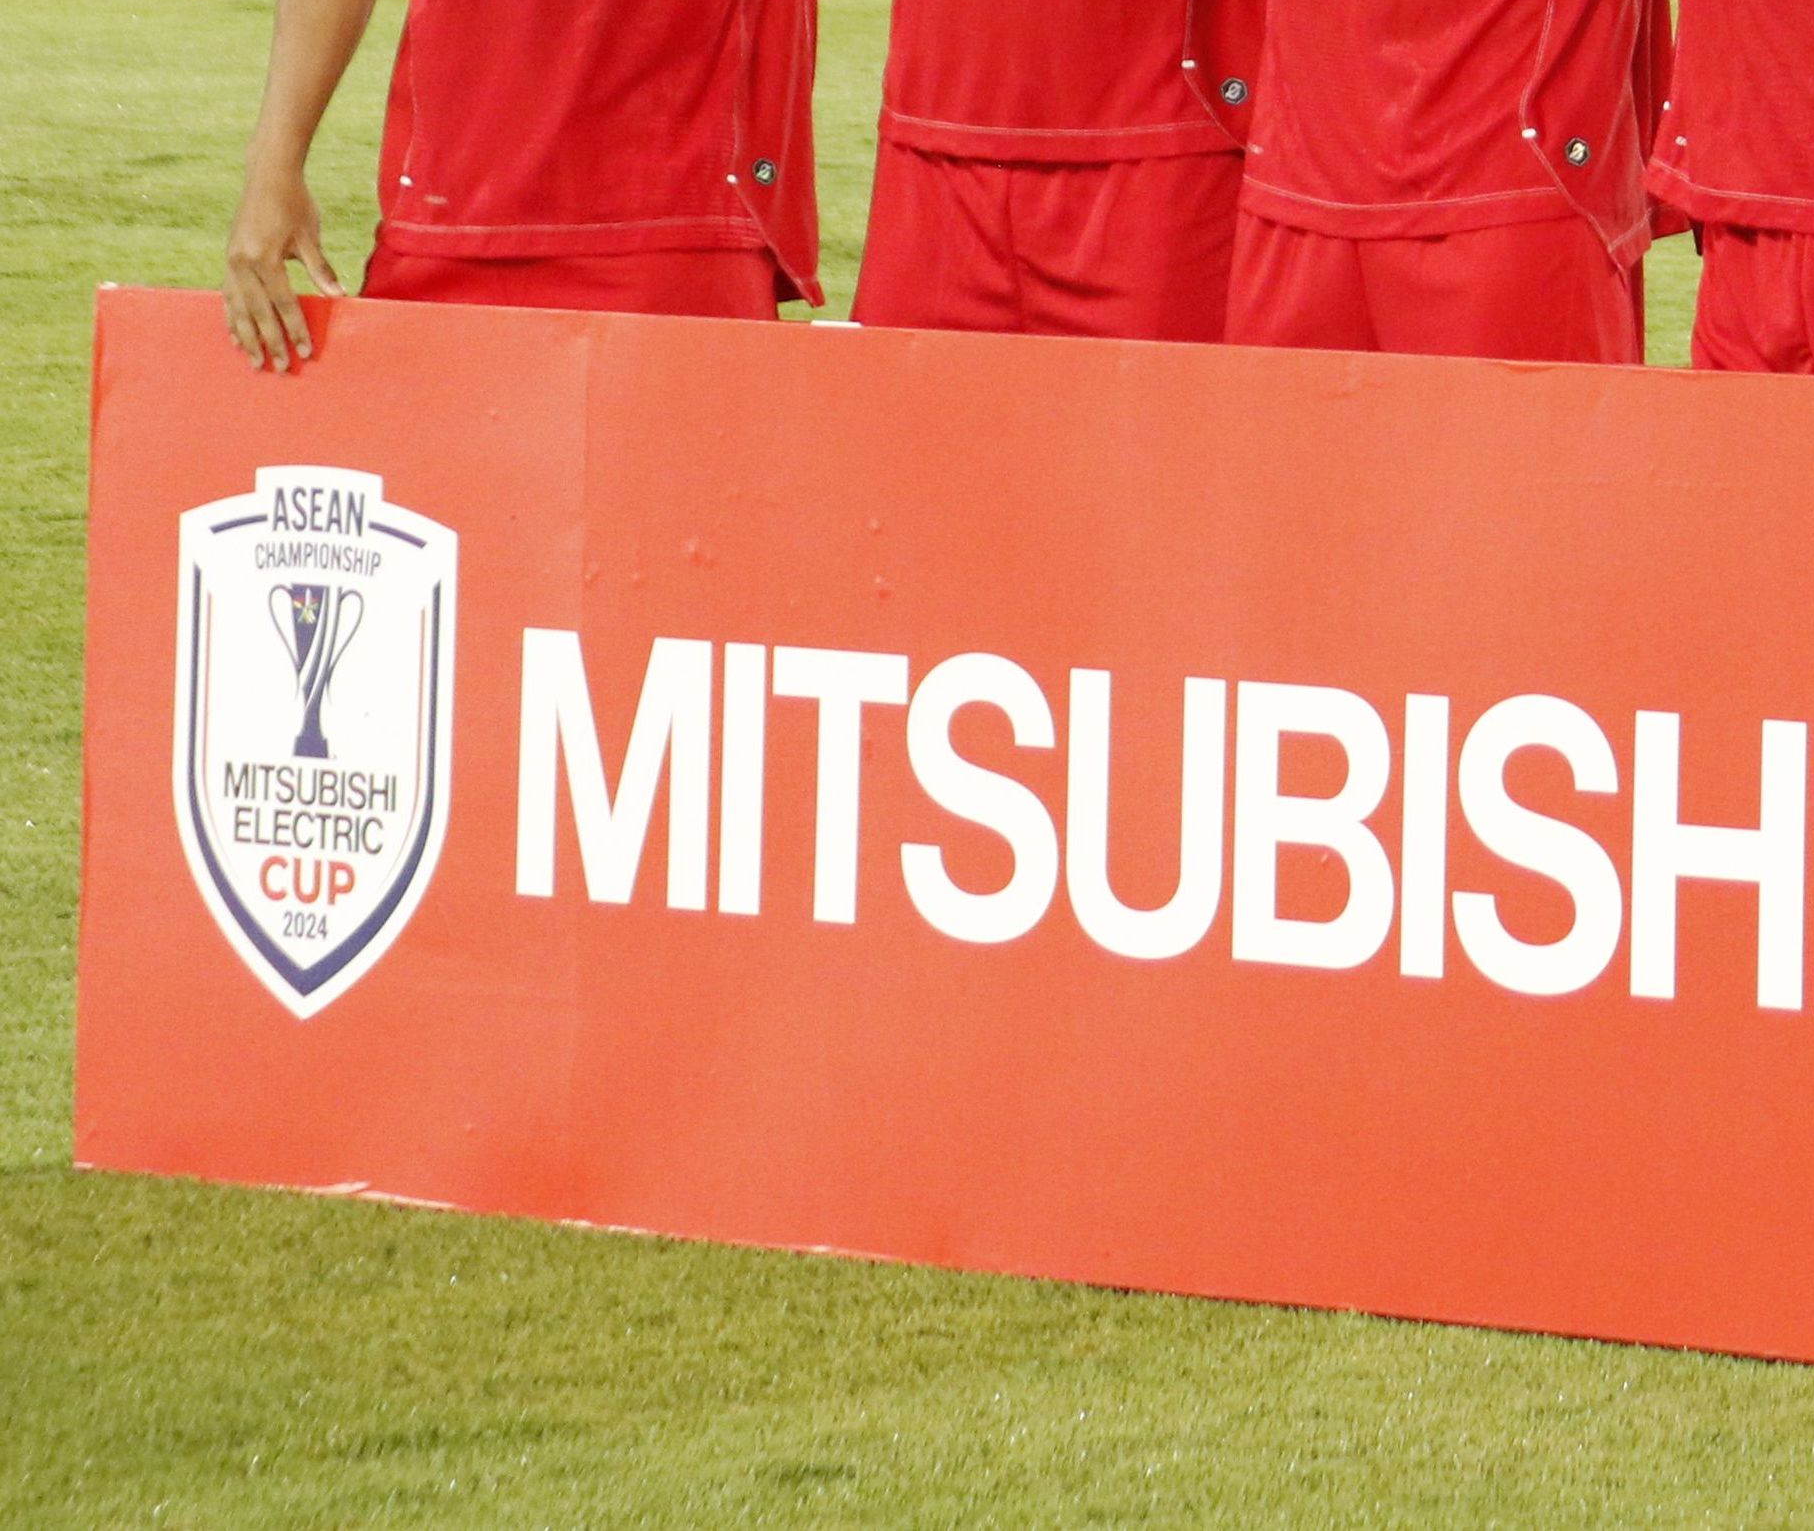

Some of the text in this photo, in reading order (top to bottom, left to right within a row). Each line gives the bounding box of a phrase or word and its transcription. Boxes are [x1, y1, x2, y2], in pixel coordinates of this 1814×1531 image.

[272, 486, 365, 537] ASEAN
[255, 541, 382, 576] CHAMPIONSHIP
[224, 761, 397, 812] MITSUBISHI
[234, 805, 384, 855] ELECTRIC
[259, 855, 357, 906] CUP
[283, 911, 329, 940] 2024
